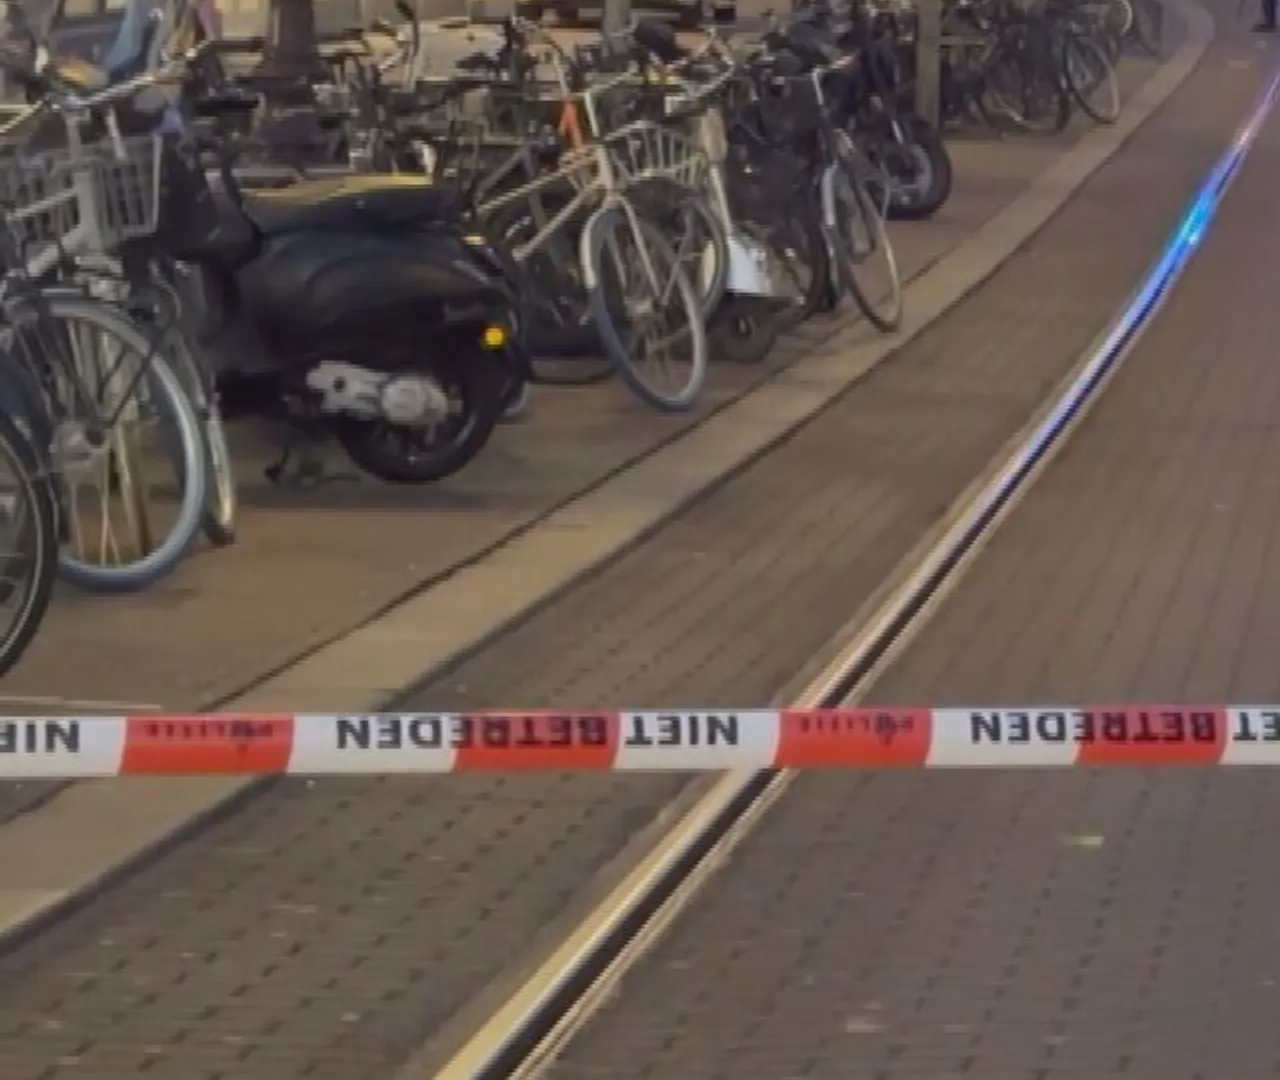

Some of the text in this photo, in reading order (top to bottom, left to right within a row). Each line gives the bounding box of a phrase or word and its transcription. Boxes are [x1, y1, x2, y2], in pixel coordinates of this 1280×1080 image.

[336, 716, 608, 751] BETREDEN
[624, 715, 739, 747] NIET
[970, 711, 1216, 744] BETREDEN
